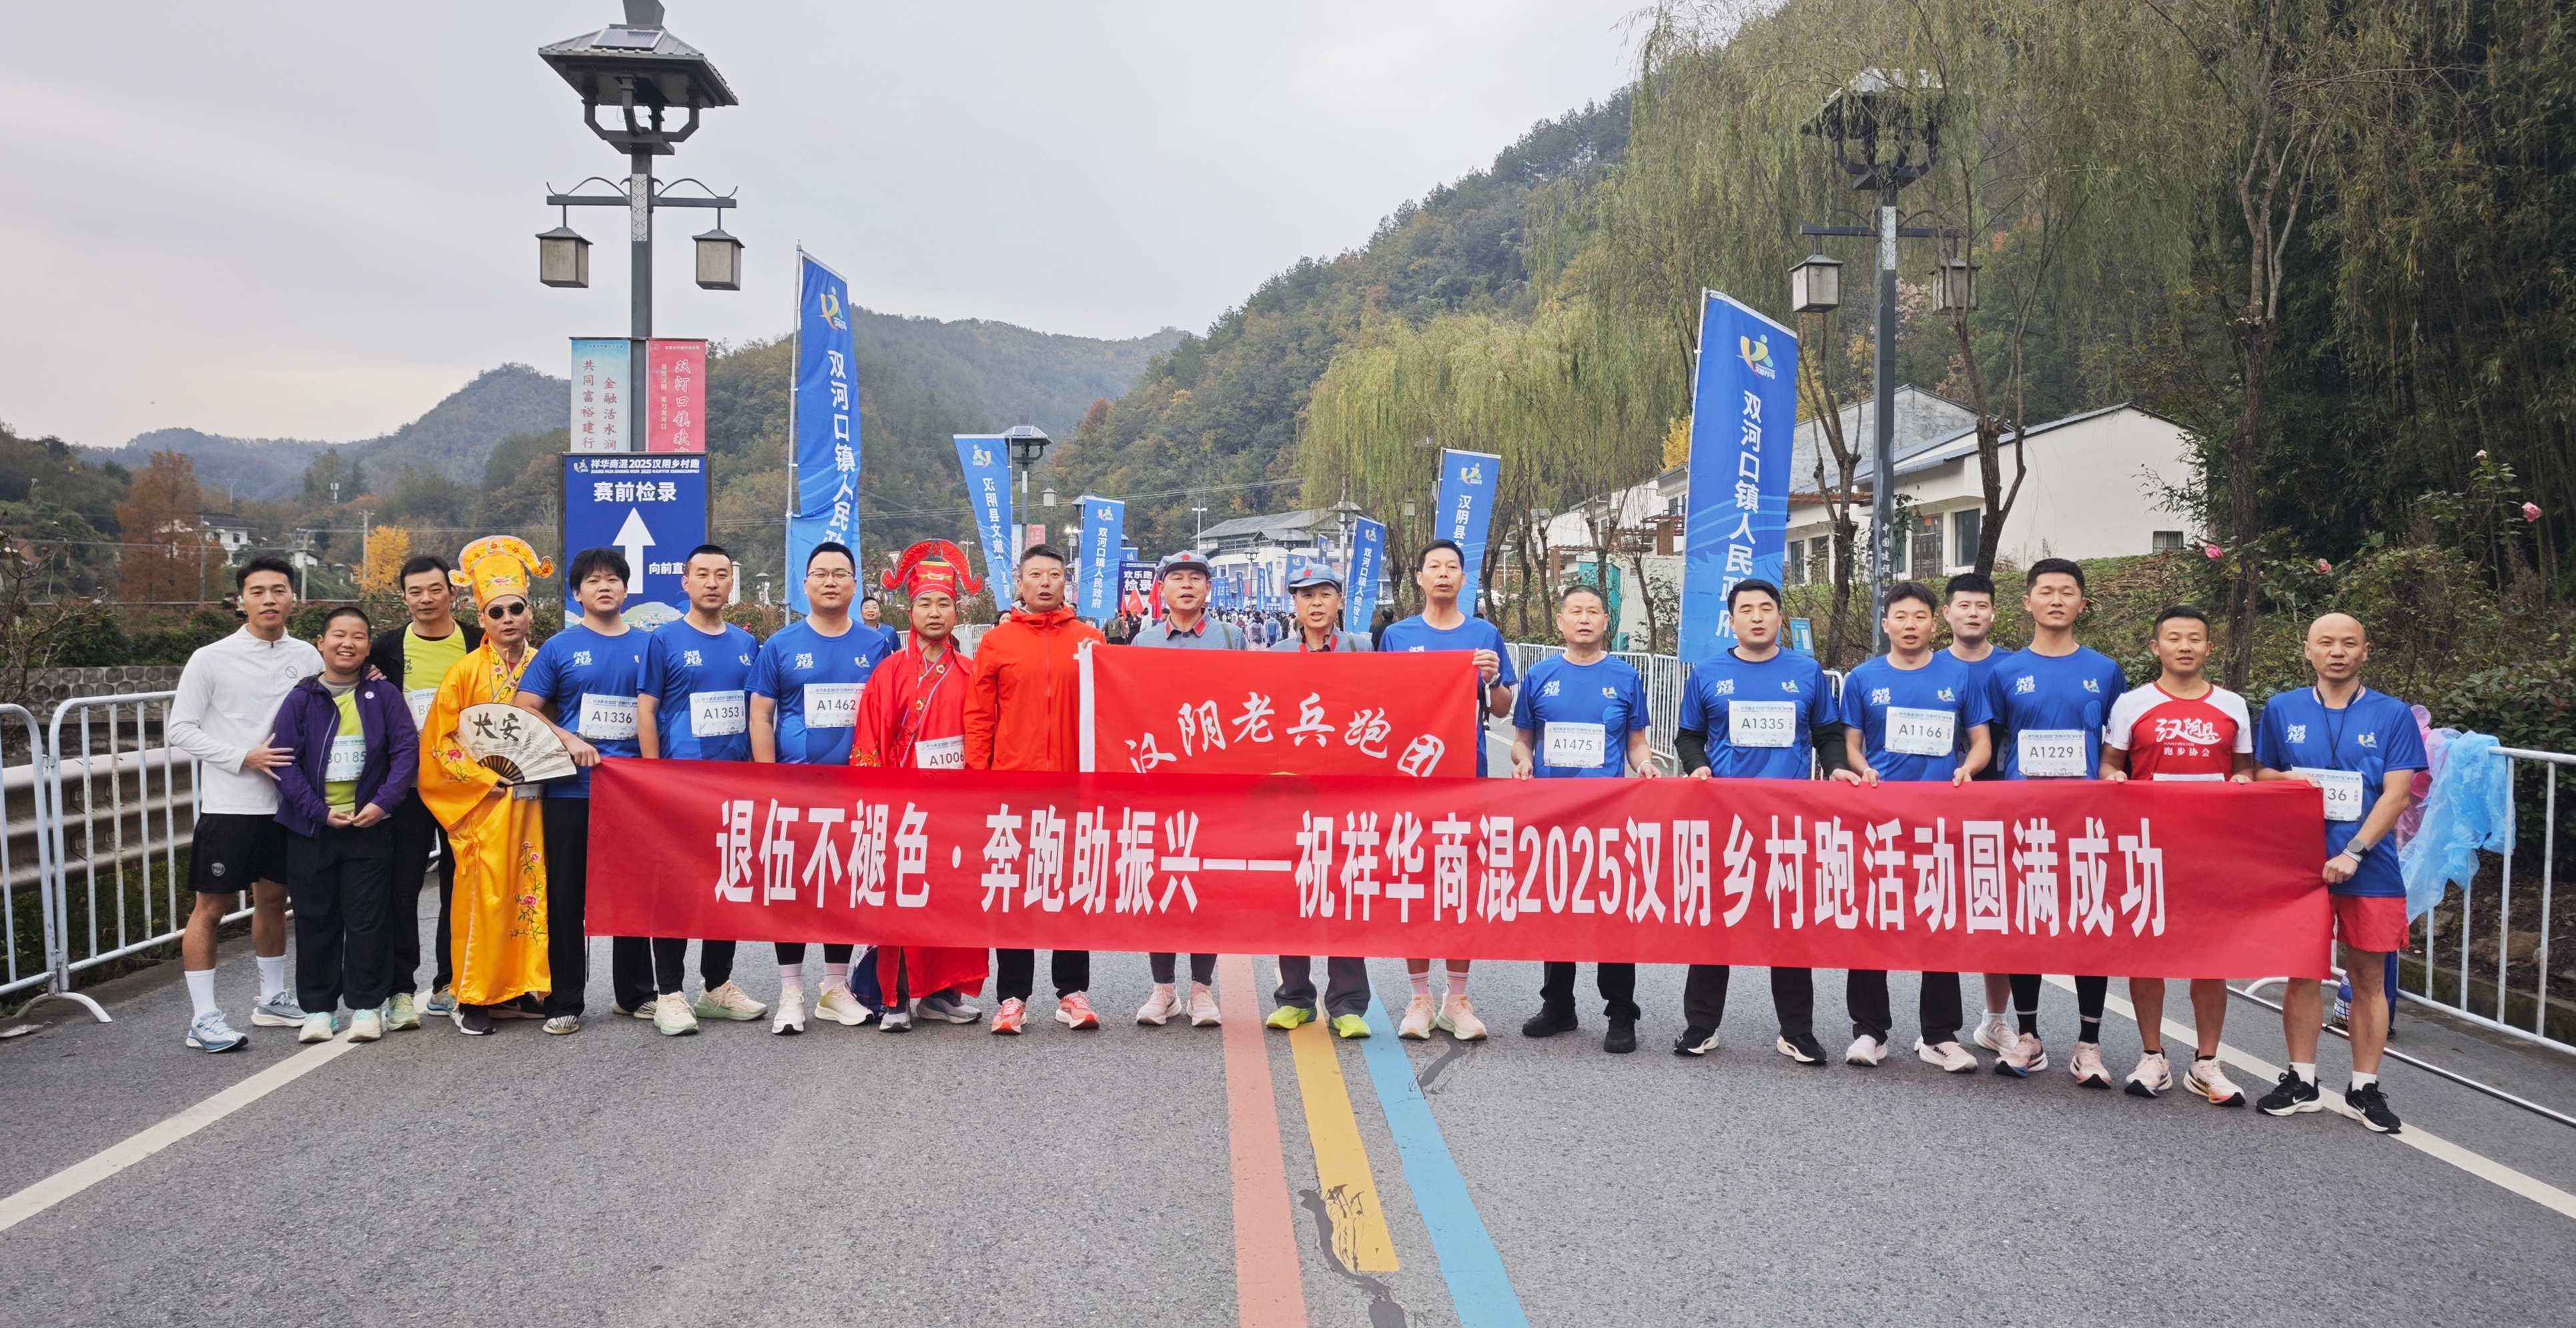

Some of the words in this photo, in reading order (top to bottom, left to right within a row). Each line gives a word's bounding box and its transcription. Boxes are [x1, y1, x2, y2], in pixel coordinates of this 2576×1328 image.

[673, 359, 691, 452] 双河口镇欢
[590, 458, 700, 469] 祥华商混2025汉阴乡村跑
[593, 482, 677, 502] 赛前检录
[649, 562, 686, 575] 向前直
[1092, 527, 1108, 609] 双河口镇人民政府
[1124, 570, 1153, 580] 欢乐跑
[1124, 579, 1153, 592] 检录
[817, 700, 856, 711] A1462
[592, 711, 632, 724] A1336
[703, 706, 739, 719] A1353
[472, 712, 521, 742] 长安
[1741, 718, 1784, 730] A1335
[1124, 692, 1446, 778] 汉阴老兵跑团
[1899, 724, 1942, 738] A1166
[2154, 718, 2222, 745] 汉阴县
[1553, 738, 1593, 750] A1475
[929, 751, 964, 766] A1006
[2030, 746, 2074, 758] A1229
[2164, 747, 2210, 758] 跑步协会
